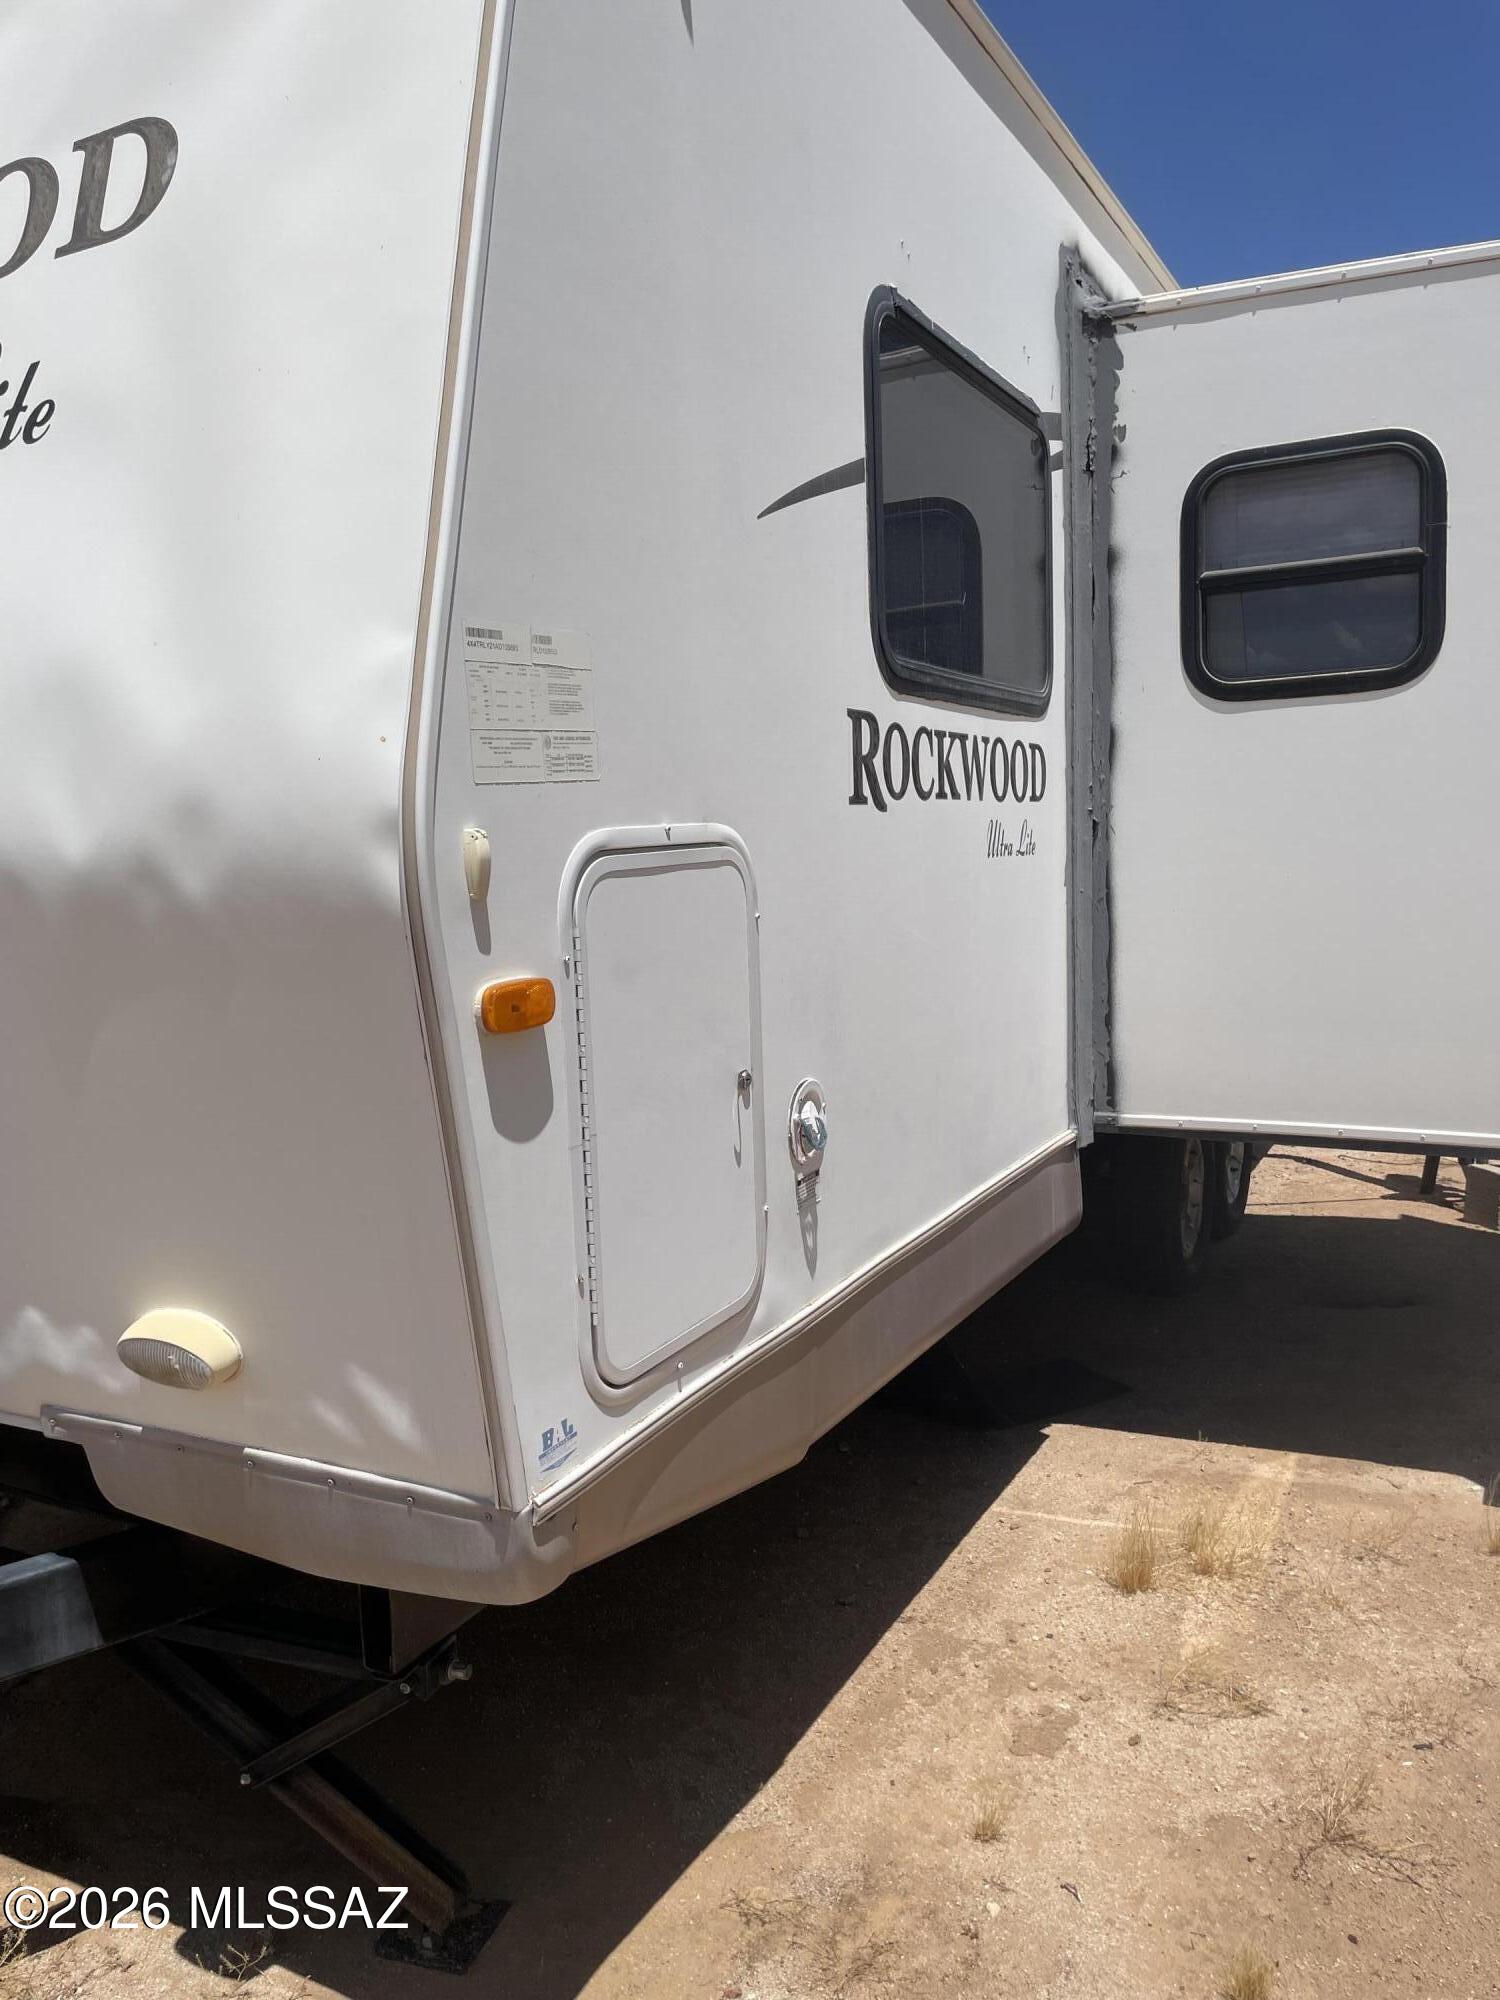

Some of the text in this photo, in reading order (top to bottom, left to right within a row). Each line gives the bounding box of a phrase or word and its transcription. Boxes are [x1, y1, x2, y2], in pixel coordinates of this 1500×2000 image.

[847, 707, 1047, 812] ROCKWOOD
[987, 818, 1037, 858] Ultra Lite
